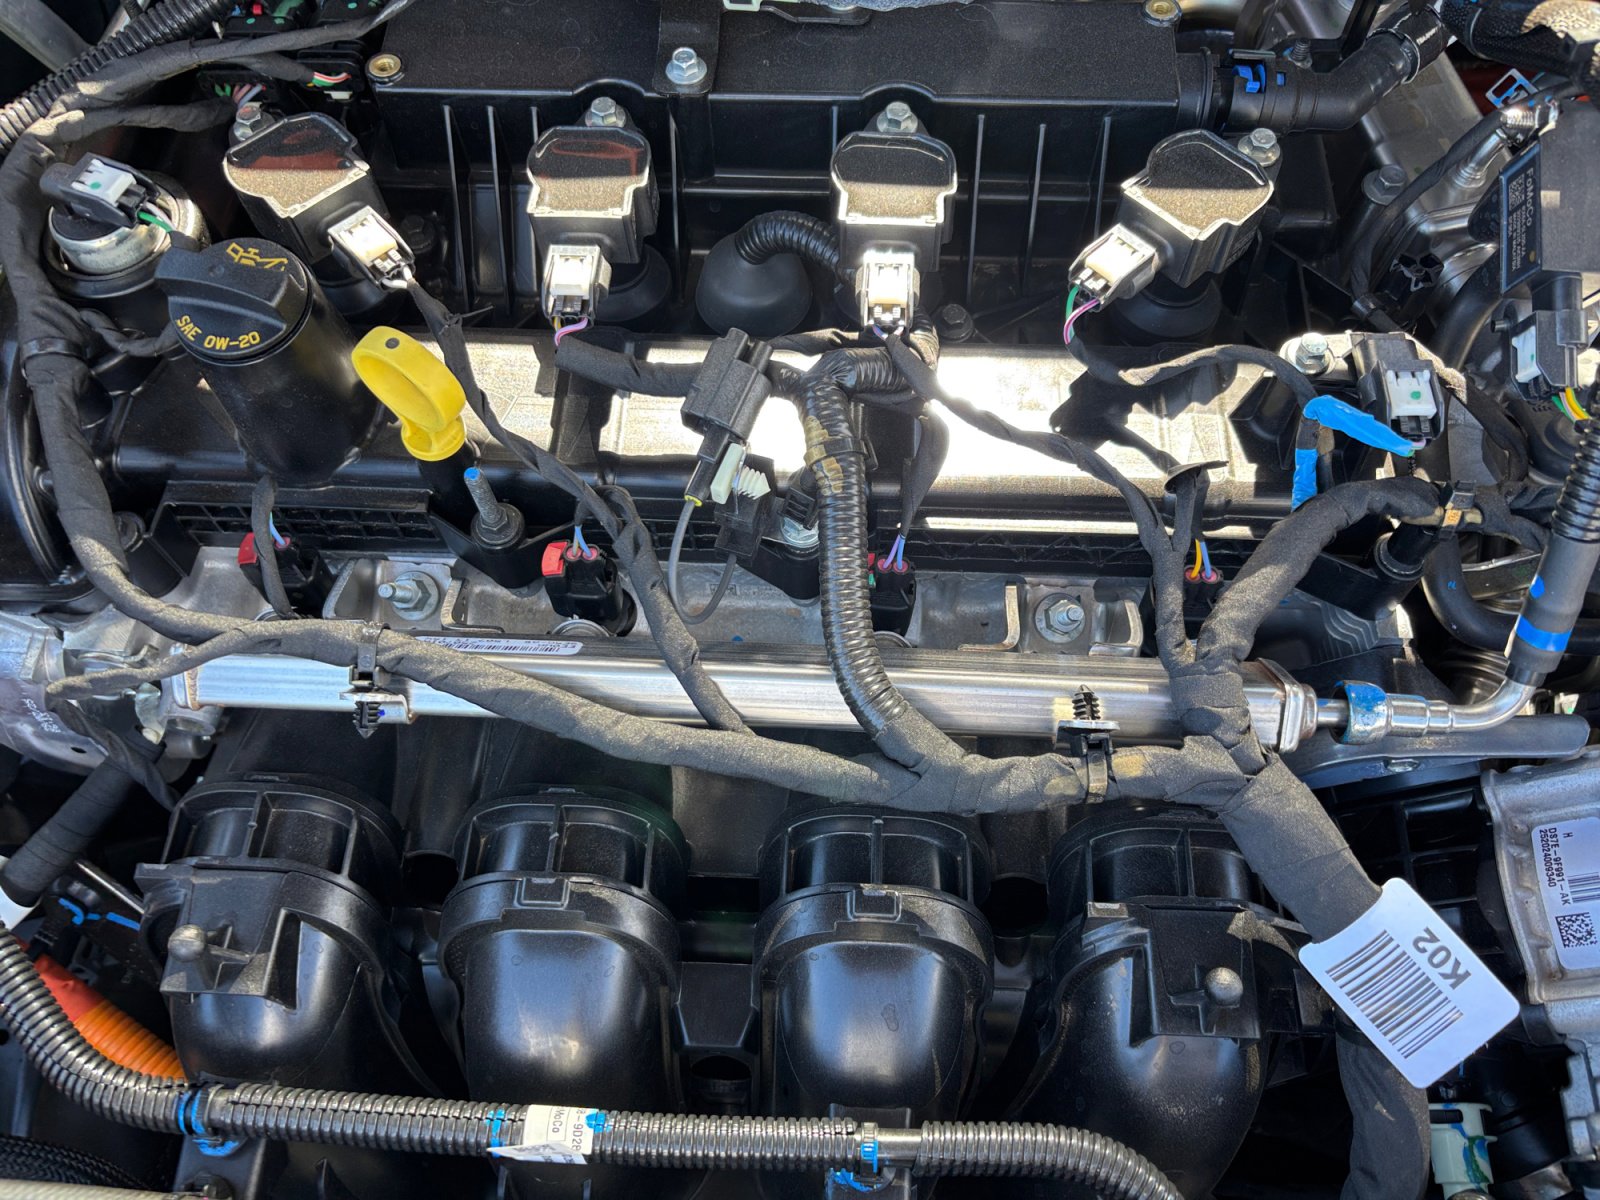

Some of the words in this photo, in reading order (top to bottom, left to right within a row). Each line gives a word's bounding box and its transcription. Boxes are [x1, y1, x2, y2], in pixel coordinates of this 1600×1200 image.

[1526, 168, 1535, 227] FoMoCo
[176, 315, 202, 341] SAE
[203, 331, 261, 350] 0W-20
[1539, 829, 1557, 887] 252024009340
[1548, 827, 1572, 905] DS7E-9F991-AK
[1412, 926, 1472, 990] K02
